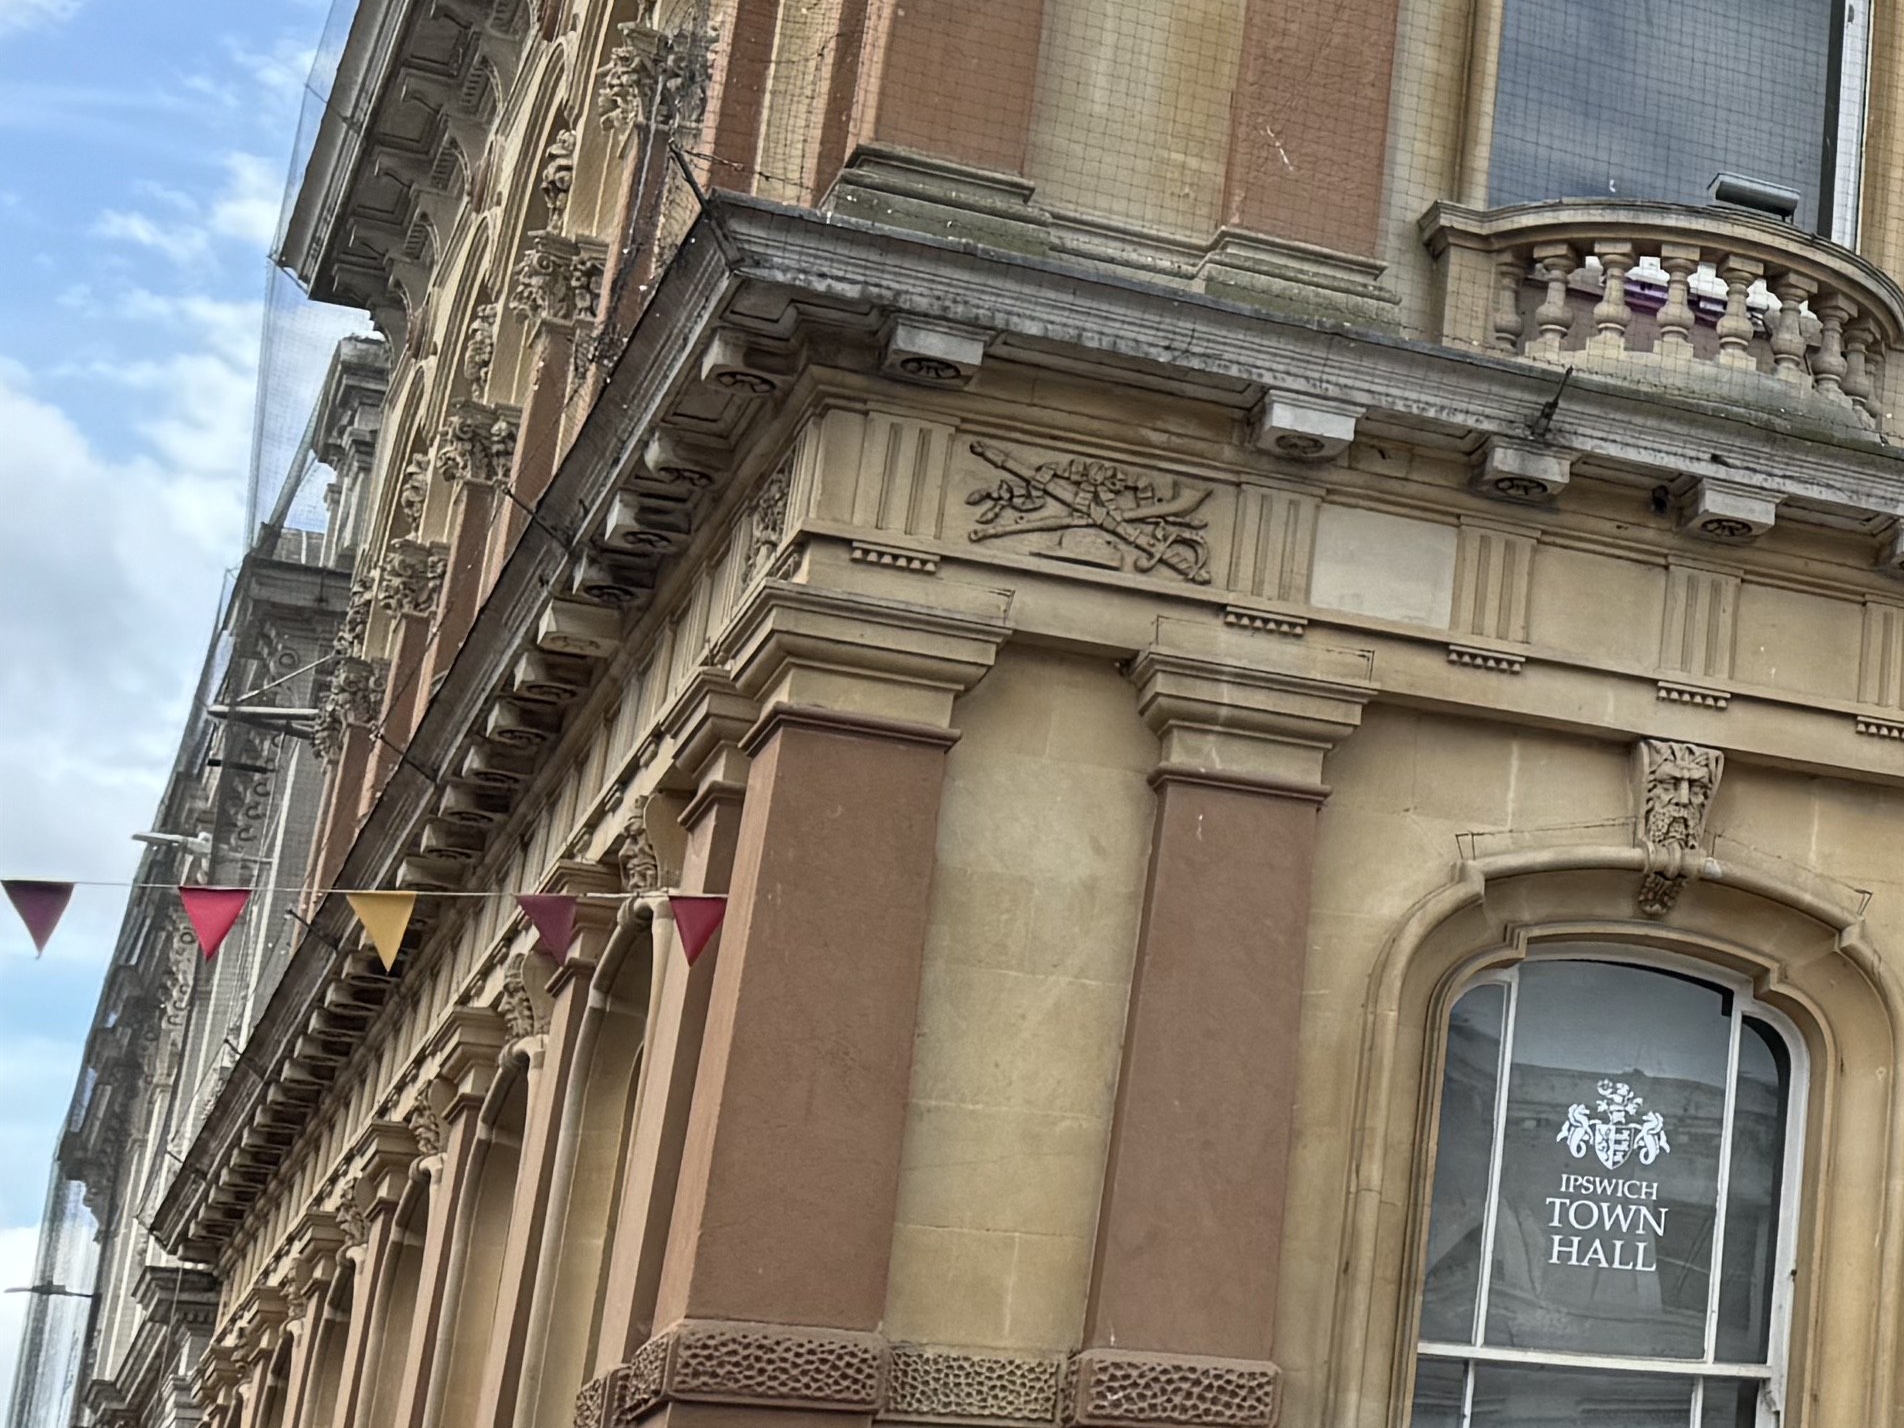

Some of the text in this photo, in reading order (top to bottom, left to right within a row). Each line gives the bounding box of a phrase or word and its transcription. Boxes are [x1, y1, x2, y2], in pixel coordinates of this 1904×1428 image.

[1560, 1173, 1658, 1200] IPSWICH
[1545, 1197, 1669, 1237] TOWN
[1548, 1234, 1657, 1272] HALL
